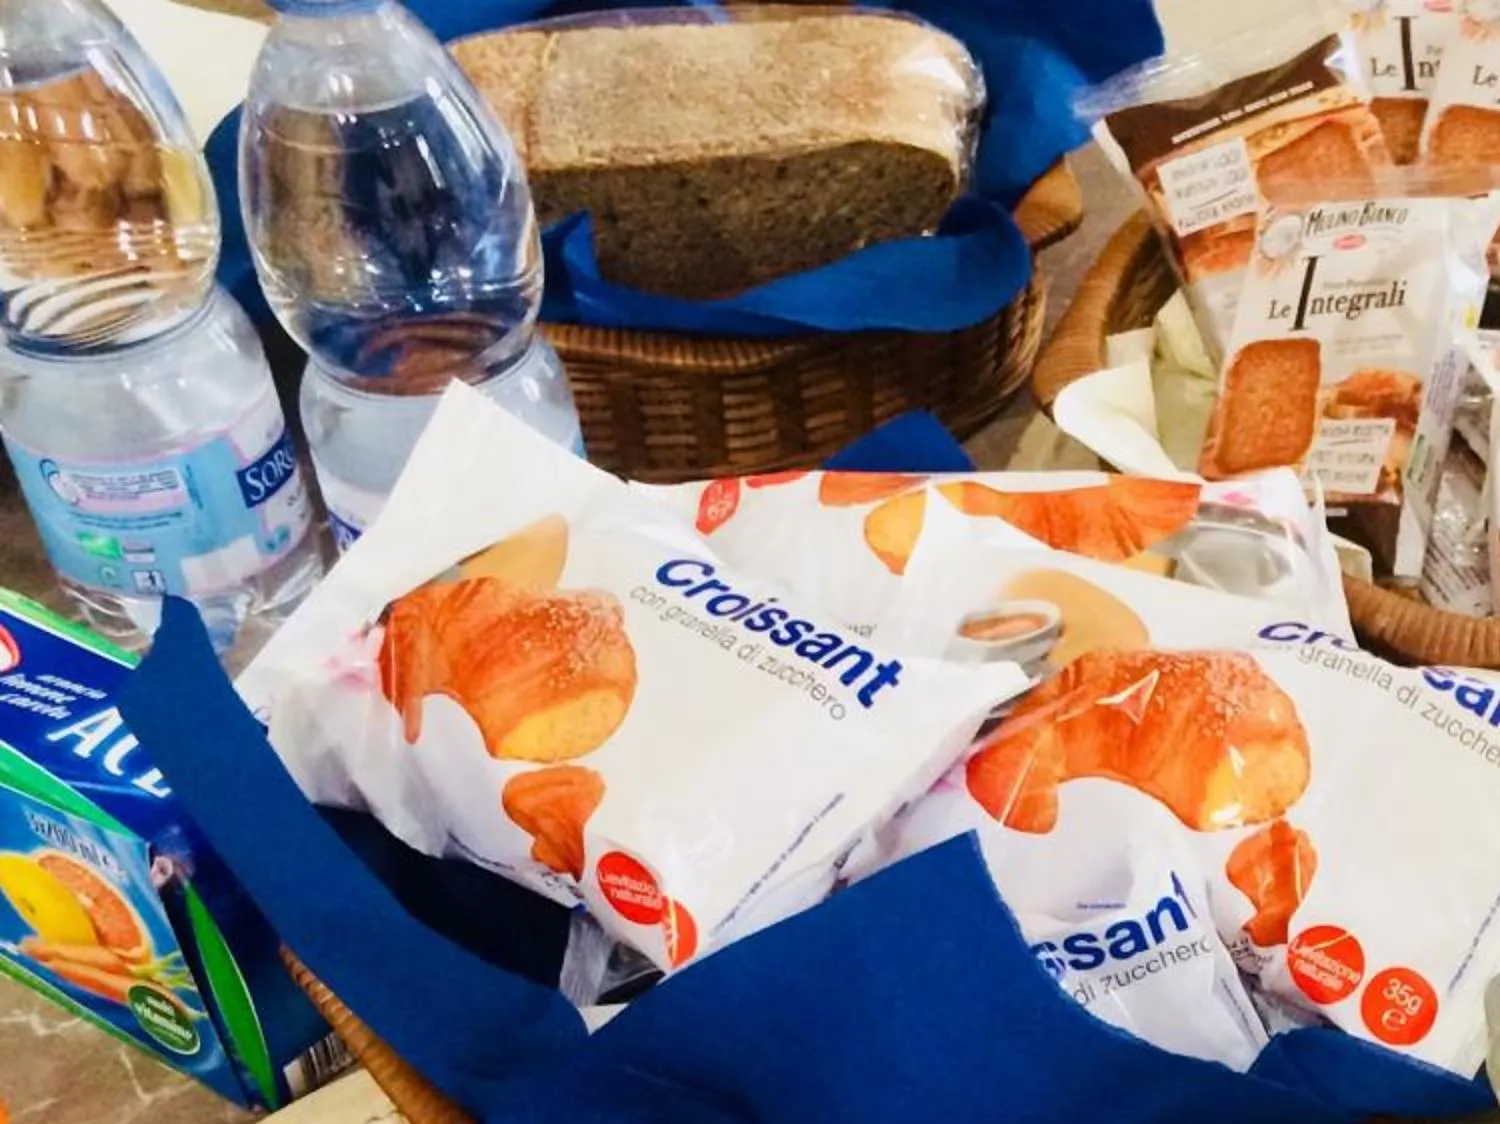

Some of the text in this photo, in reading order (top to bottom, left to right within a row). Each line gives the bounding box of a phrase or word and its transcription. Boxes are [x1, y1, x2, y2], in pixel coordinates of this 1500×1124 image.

[1370, 57, 1398, 79] Le
[1471, 64, 1499, 88] Le
[1267, 255, 1408, 332] Le Integrali
[656, 559, 903, 709] Croissant
[736, 641, 760, 663] di
[1298, 645, 1394, 692] granella
[1396, 684, 1422, 709] di
[1381, 977, 1424, 1017] 35g
